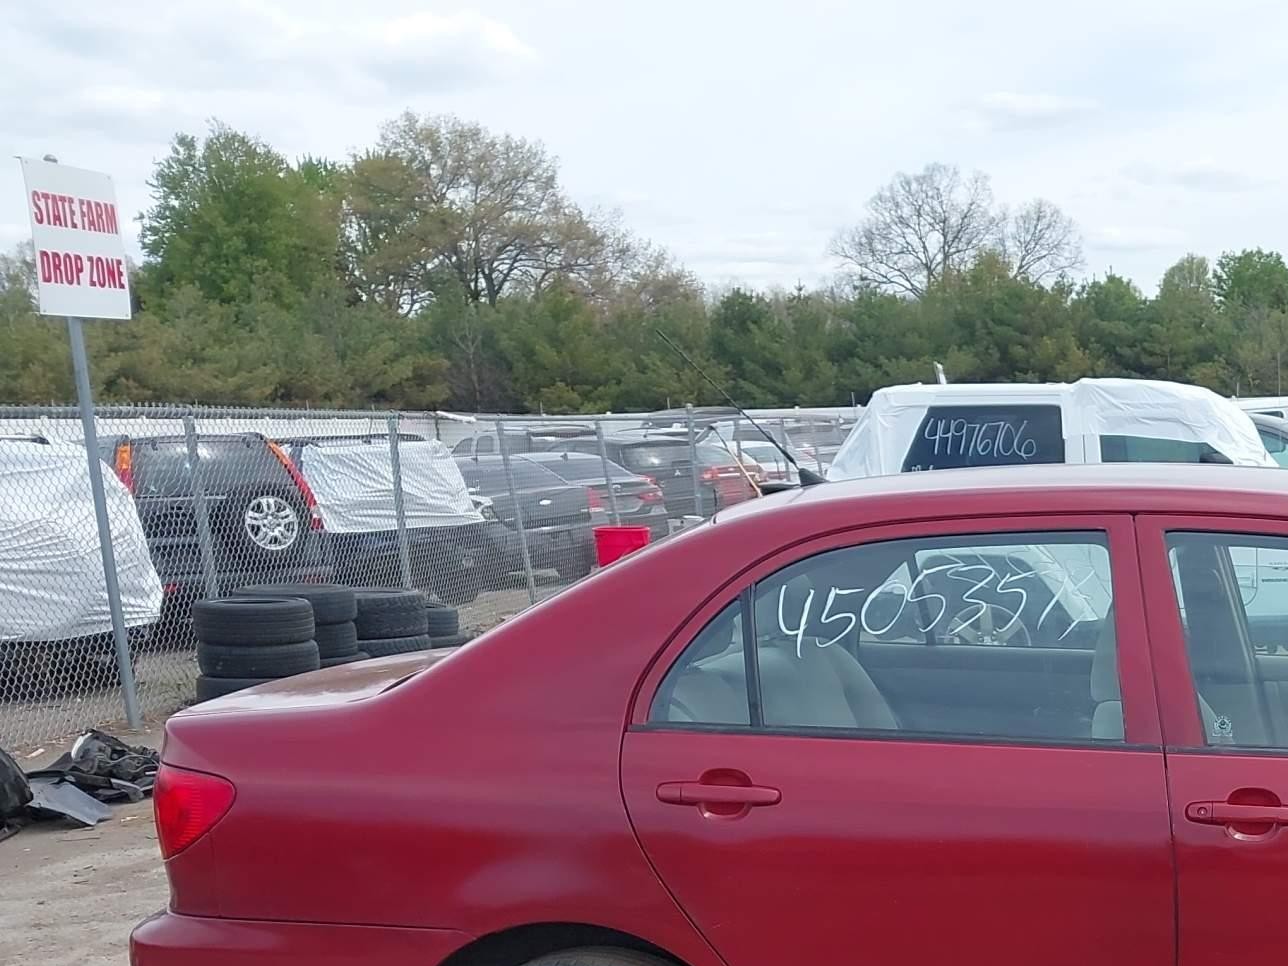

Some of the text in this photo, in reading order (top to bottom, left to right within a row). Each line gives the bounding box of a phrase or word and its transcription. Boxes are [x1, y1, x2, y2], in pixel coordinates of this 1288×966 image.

[32, 190, 118, 235] STATE FARM
[40, 251, 126, 290] DROP ZONE
[924, 418, 1037, 461] 44976706
